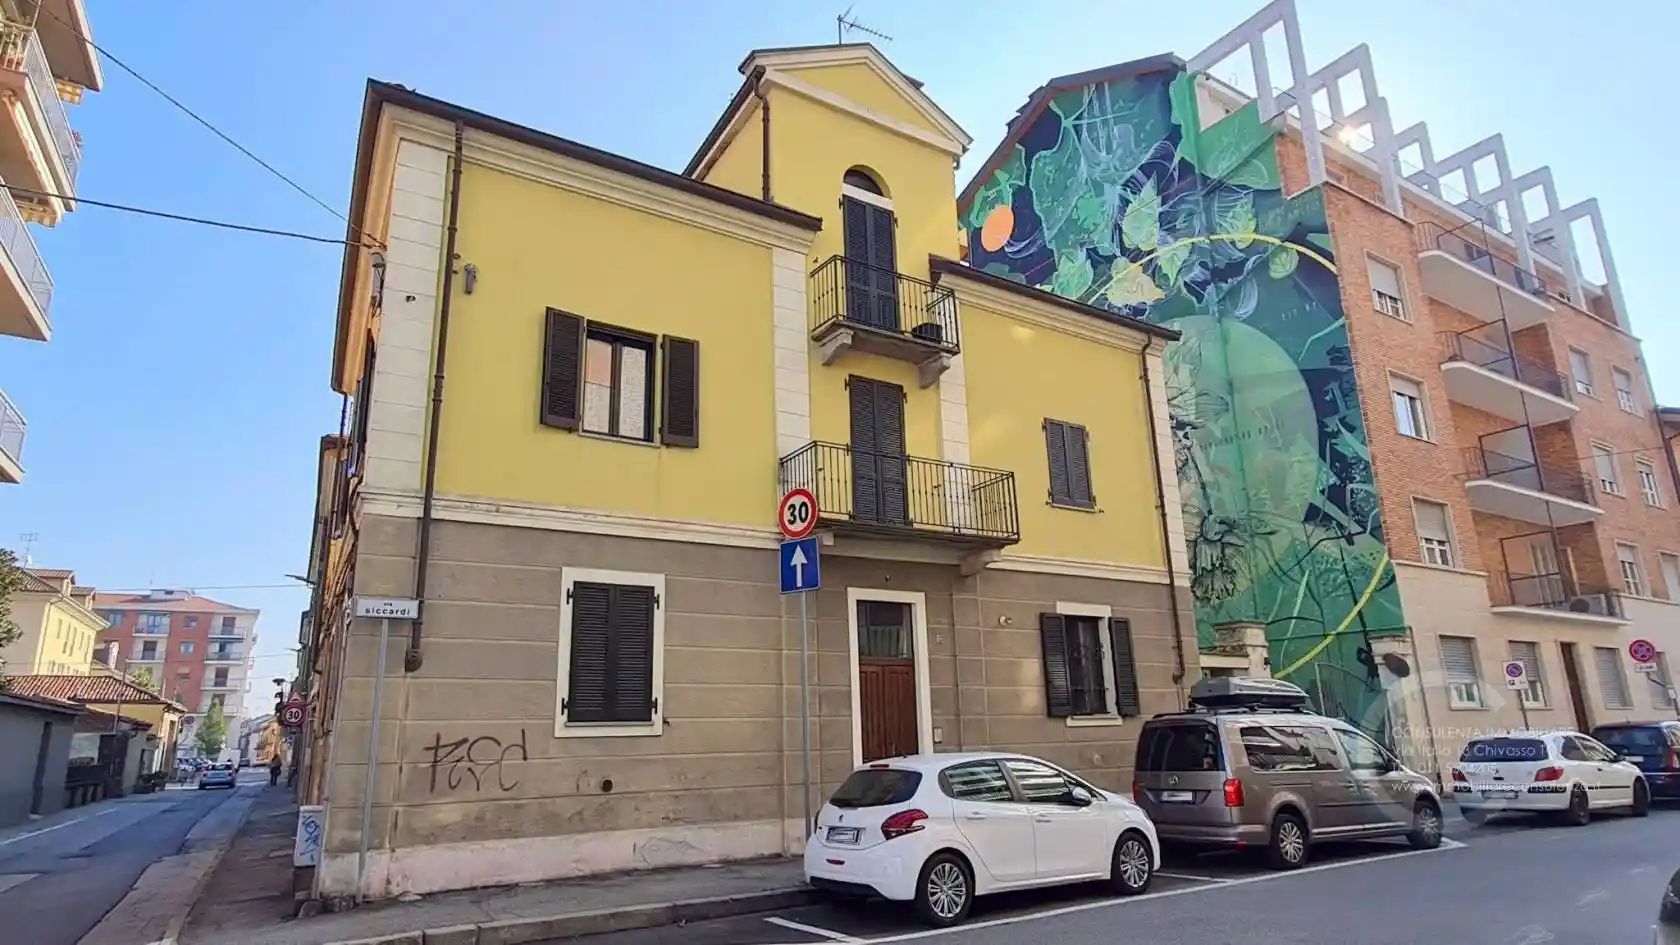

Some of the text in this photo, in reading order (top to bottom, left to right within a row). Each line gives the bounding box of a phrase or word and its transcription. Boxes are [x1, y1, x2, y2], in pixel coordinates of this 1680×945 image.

[787, 501, 809, 525] 30
[365, 608, 410, 616] siccardi
[287, 710, 300, 720] 30
